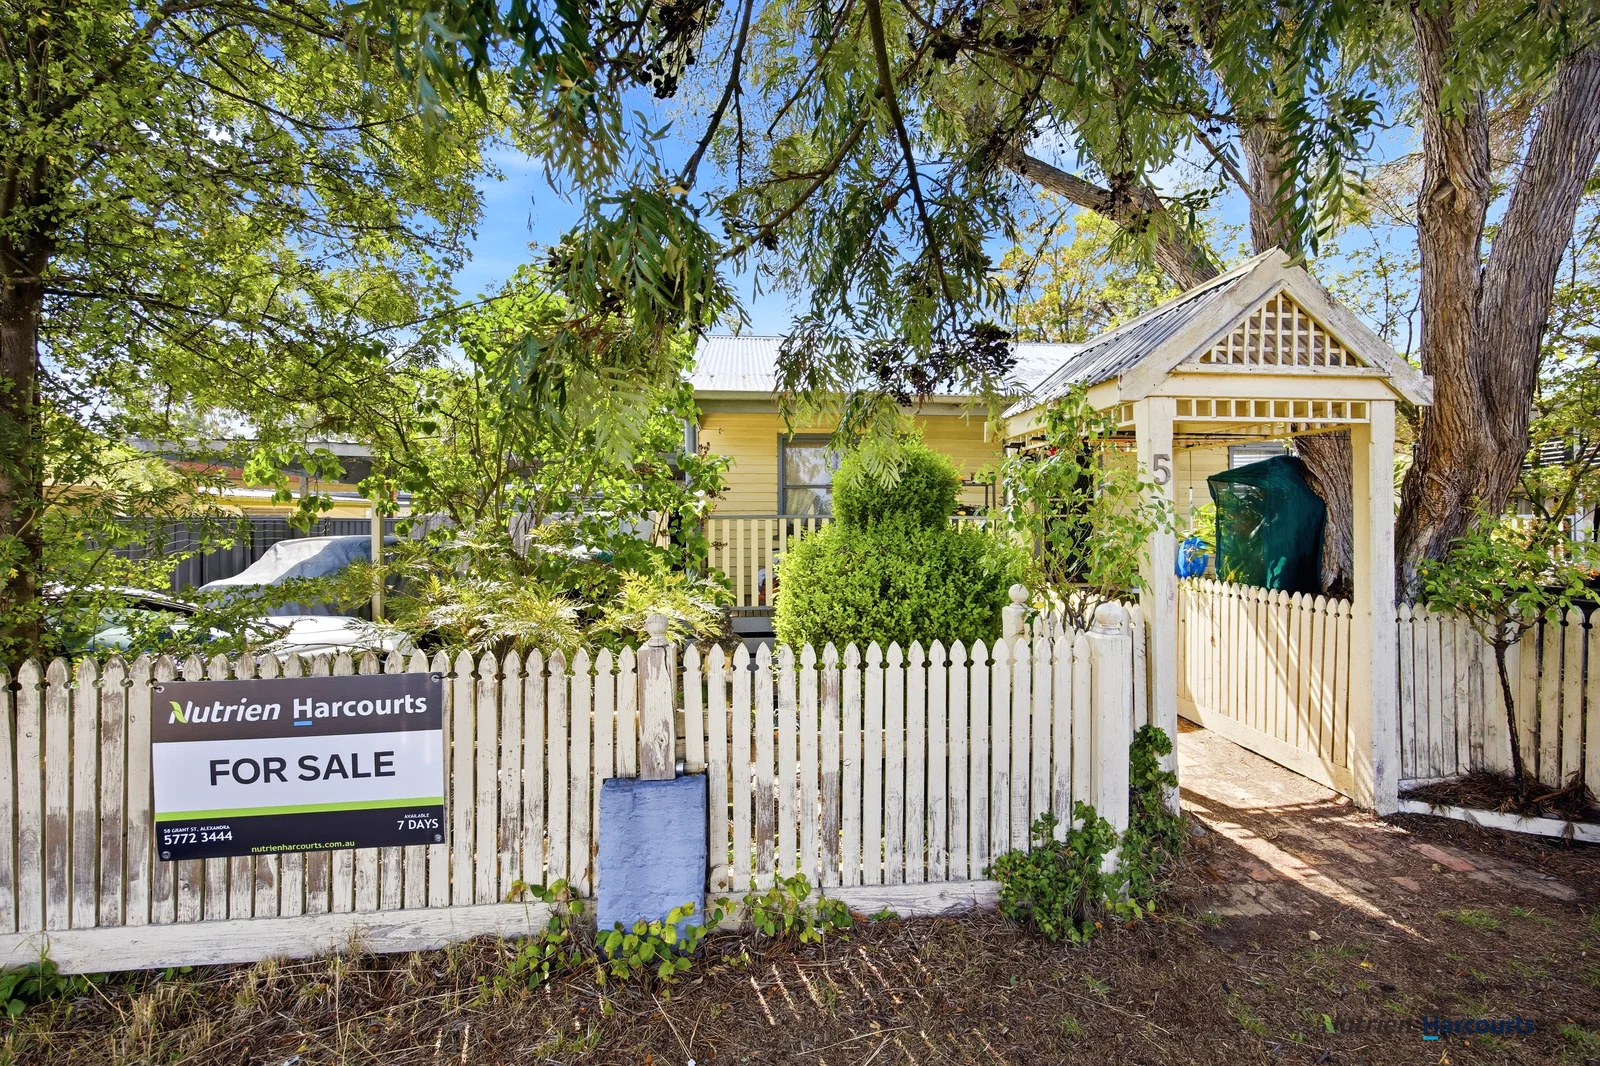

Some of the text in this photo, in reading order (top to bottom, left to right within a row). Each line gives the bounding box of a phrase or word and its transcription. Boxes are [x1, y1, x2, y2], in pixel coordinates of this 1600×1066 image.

[1153, 453, 1171, 486] 5
[168, 694, 428, 724] Nutrien Harcourts
[209, 750, 396, 786] FOR SALE
[397, 818, 439, 831] 7 DAYS
[164, 830, 233, 846] 5772 3444
[251, 840, 355, 854] nutrienharcourts.com.au
